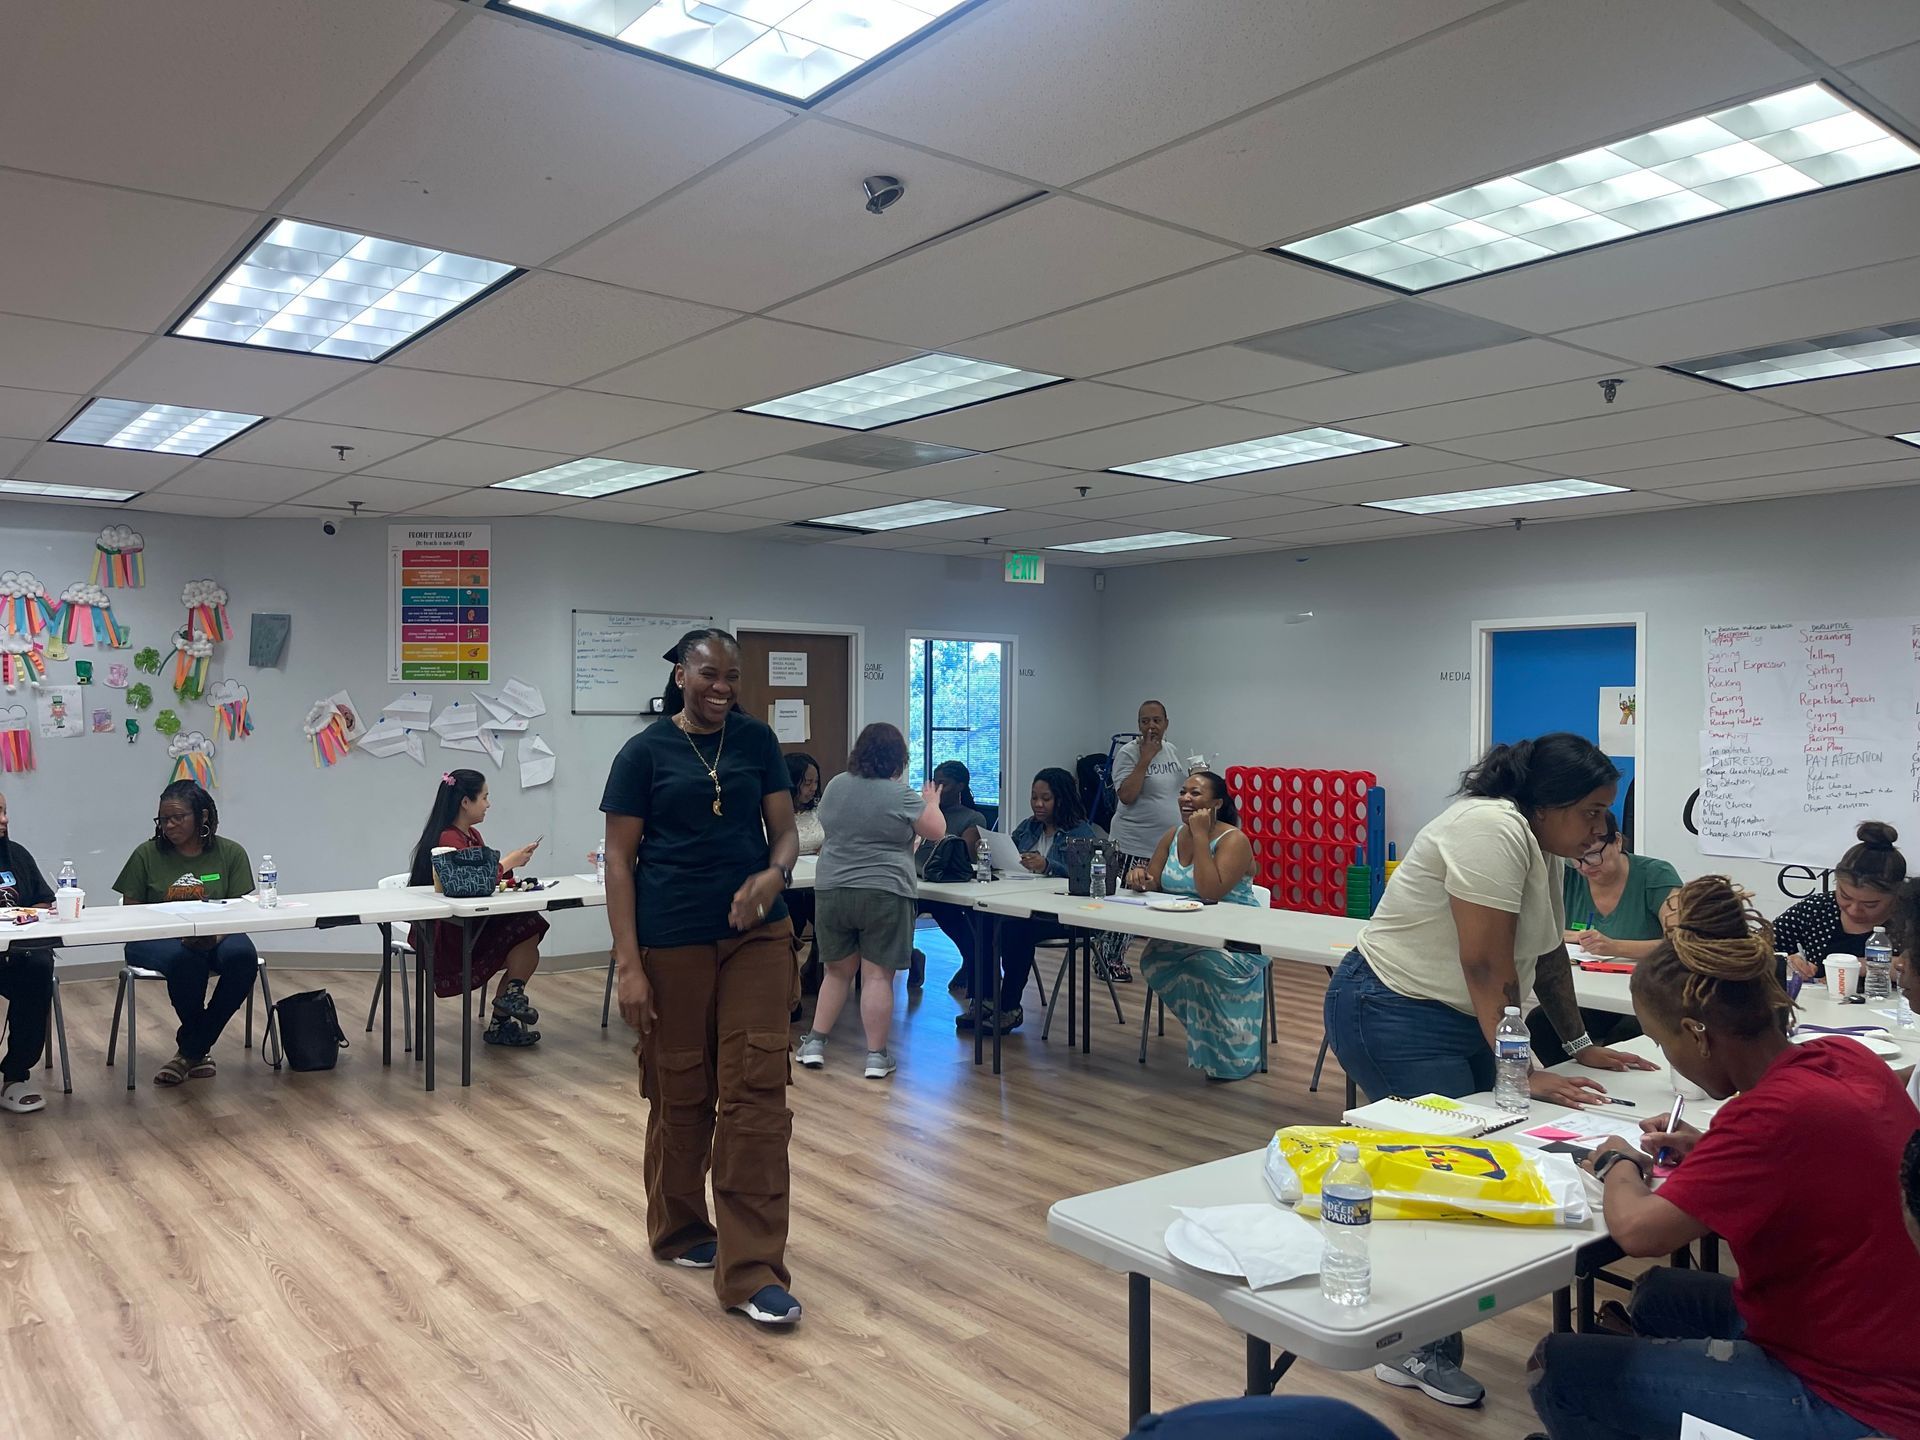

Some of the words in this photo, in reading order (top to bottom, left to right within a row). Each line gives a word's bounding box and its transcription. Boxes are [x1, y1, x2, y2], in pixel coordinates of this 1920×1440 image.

[1012, 554, 1039, 580] EXIT
[1800, 629, 1852, 646] Screaming
[1805, 646, 1835, 664] Yelling
[864, 664, 883, 672] GAME
[864, 671, 884, 680] ROOM
[1440, 671, 1471, 681] MEDIA
[1711, 756, 1773, 768] DISTRESSED
[1805, 753, 1828, 767] PAY
[1832, 751, 1883, 767] ATTENTION
[1328, 1201, 1355, 1214] DEER
[1328, 1211, 1355, 1224] PARK
